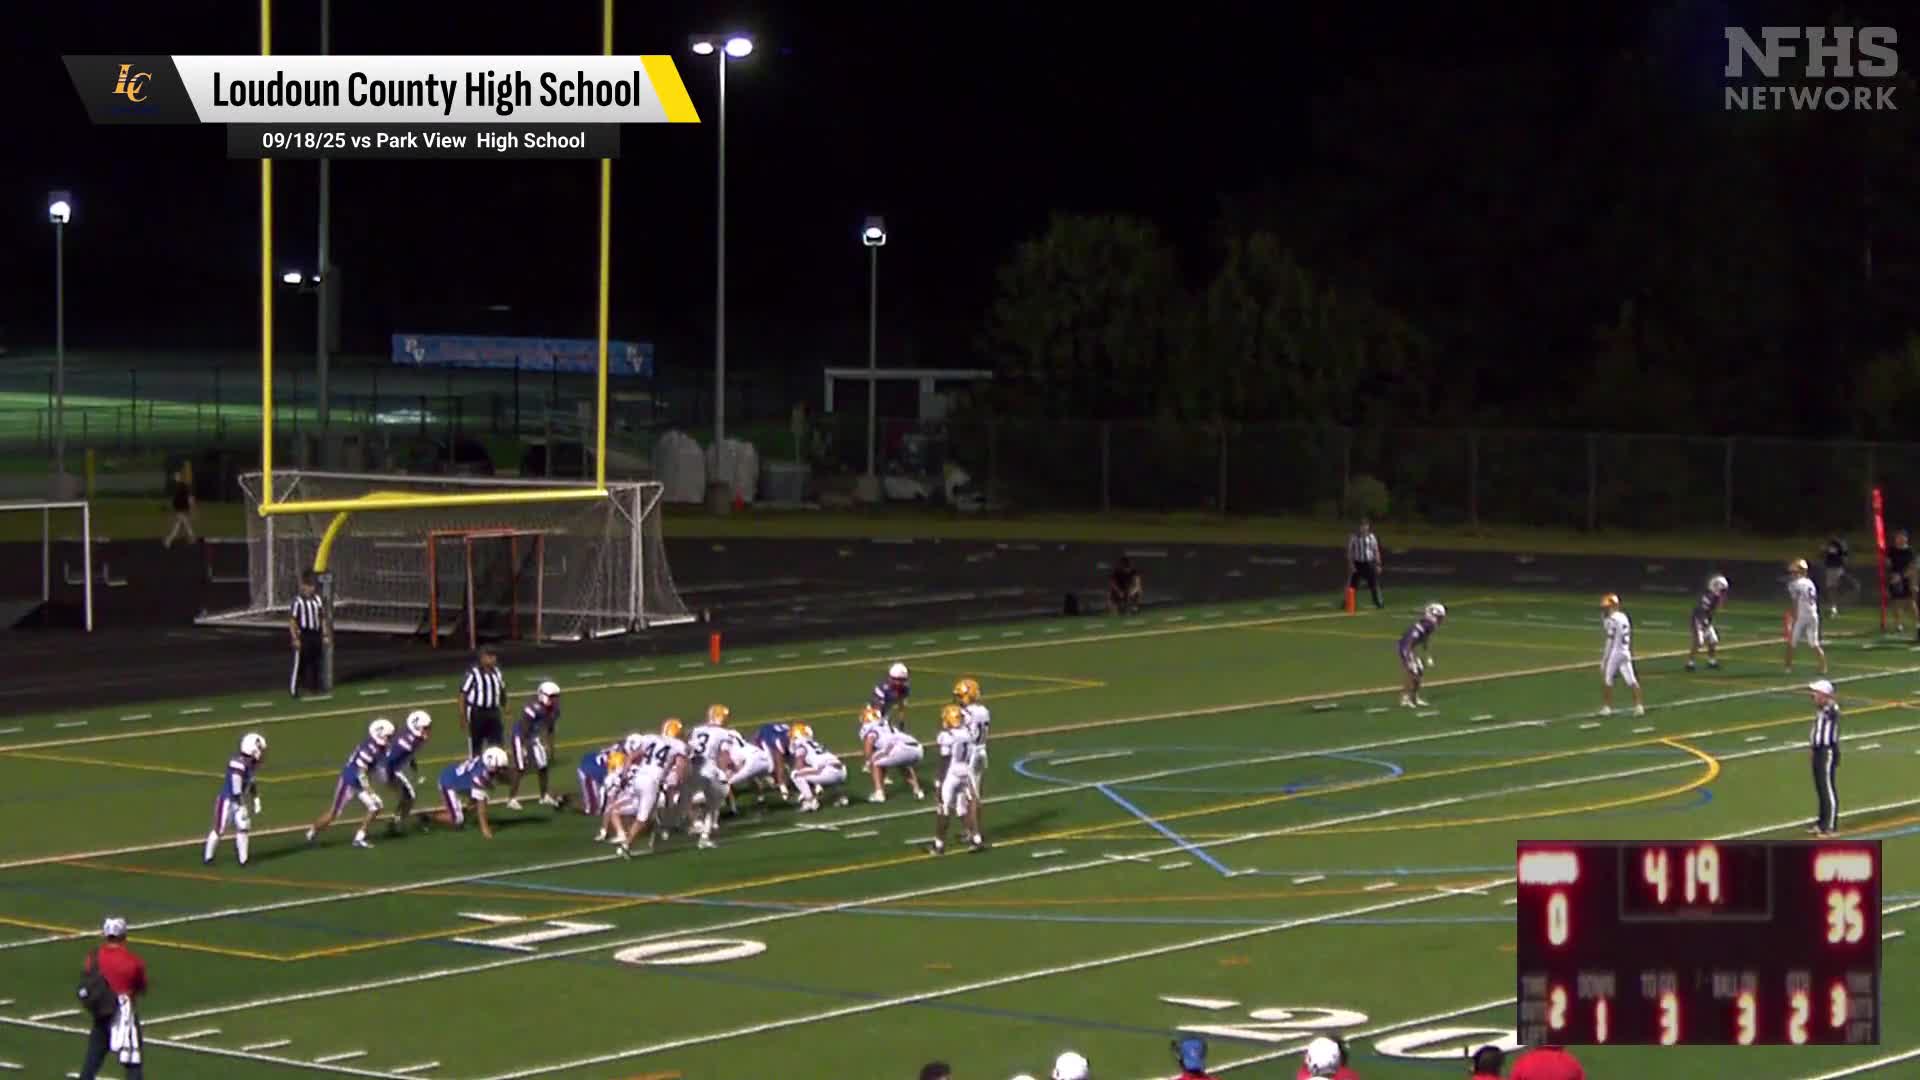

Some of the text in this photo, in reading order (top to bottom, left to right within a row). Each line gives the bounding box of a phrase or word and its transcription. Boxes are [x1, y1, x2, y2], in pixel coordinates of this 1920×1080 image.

[643, 741, 672, 768] 44
[693, 732, 710, 755] 3
[1547, 892, 1568, 946] 0
[1826, 889, 1864, 944] 35
[1595, 999, 1608, 1044] 1
[1660, 992, 1680, 1045] 3
[1737, 991, 1757, 1045] 3
[1789, 991, 1810, 1045] 2
